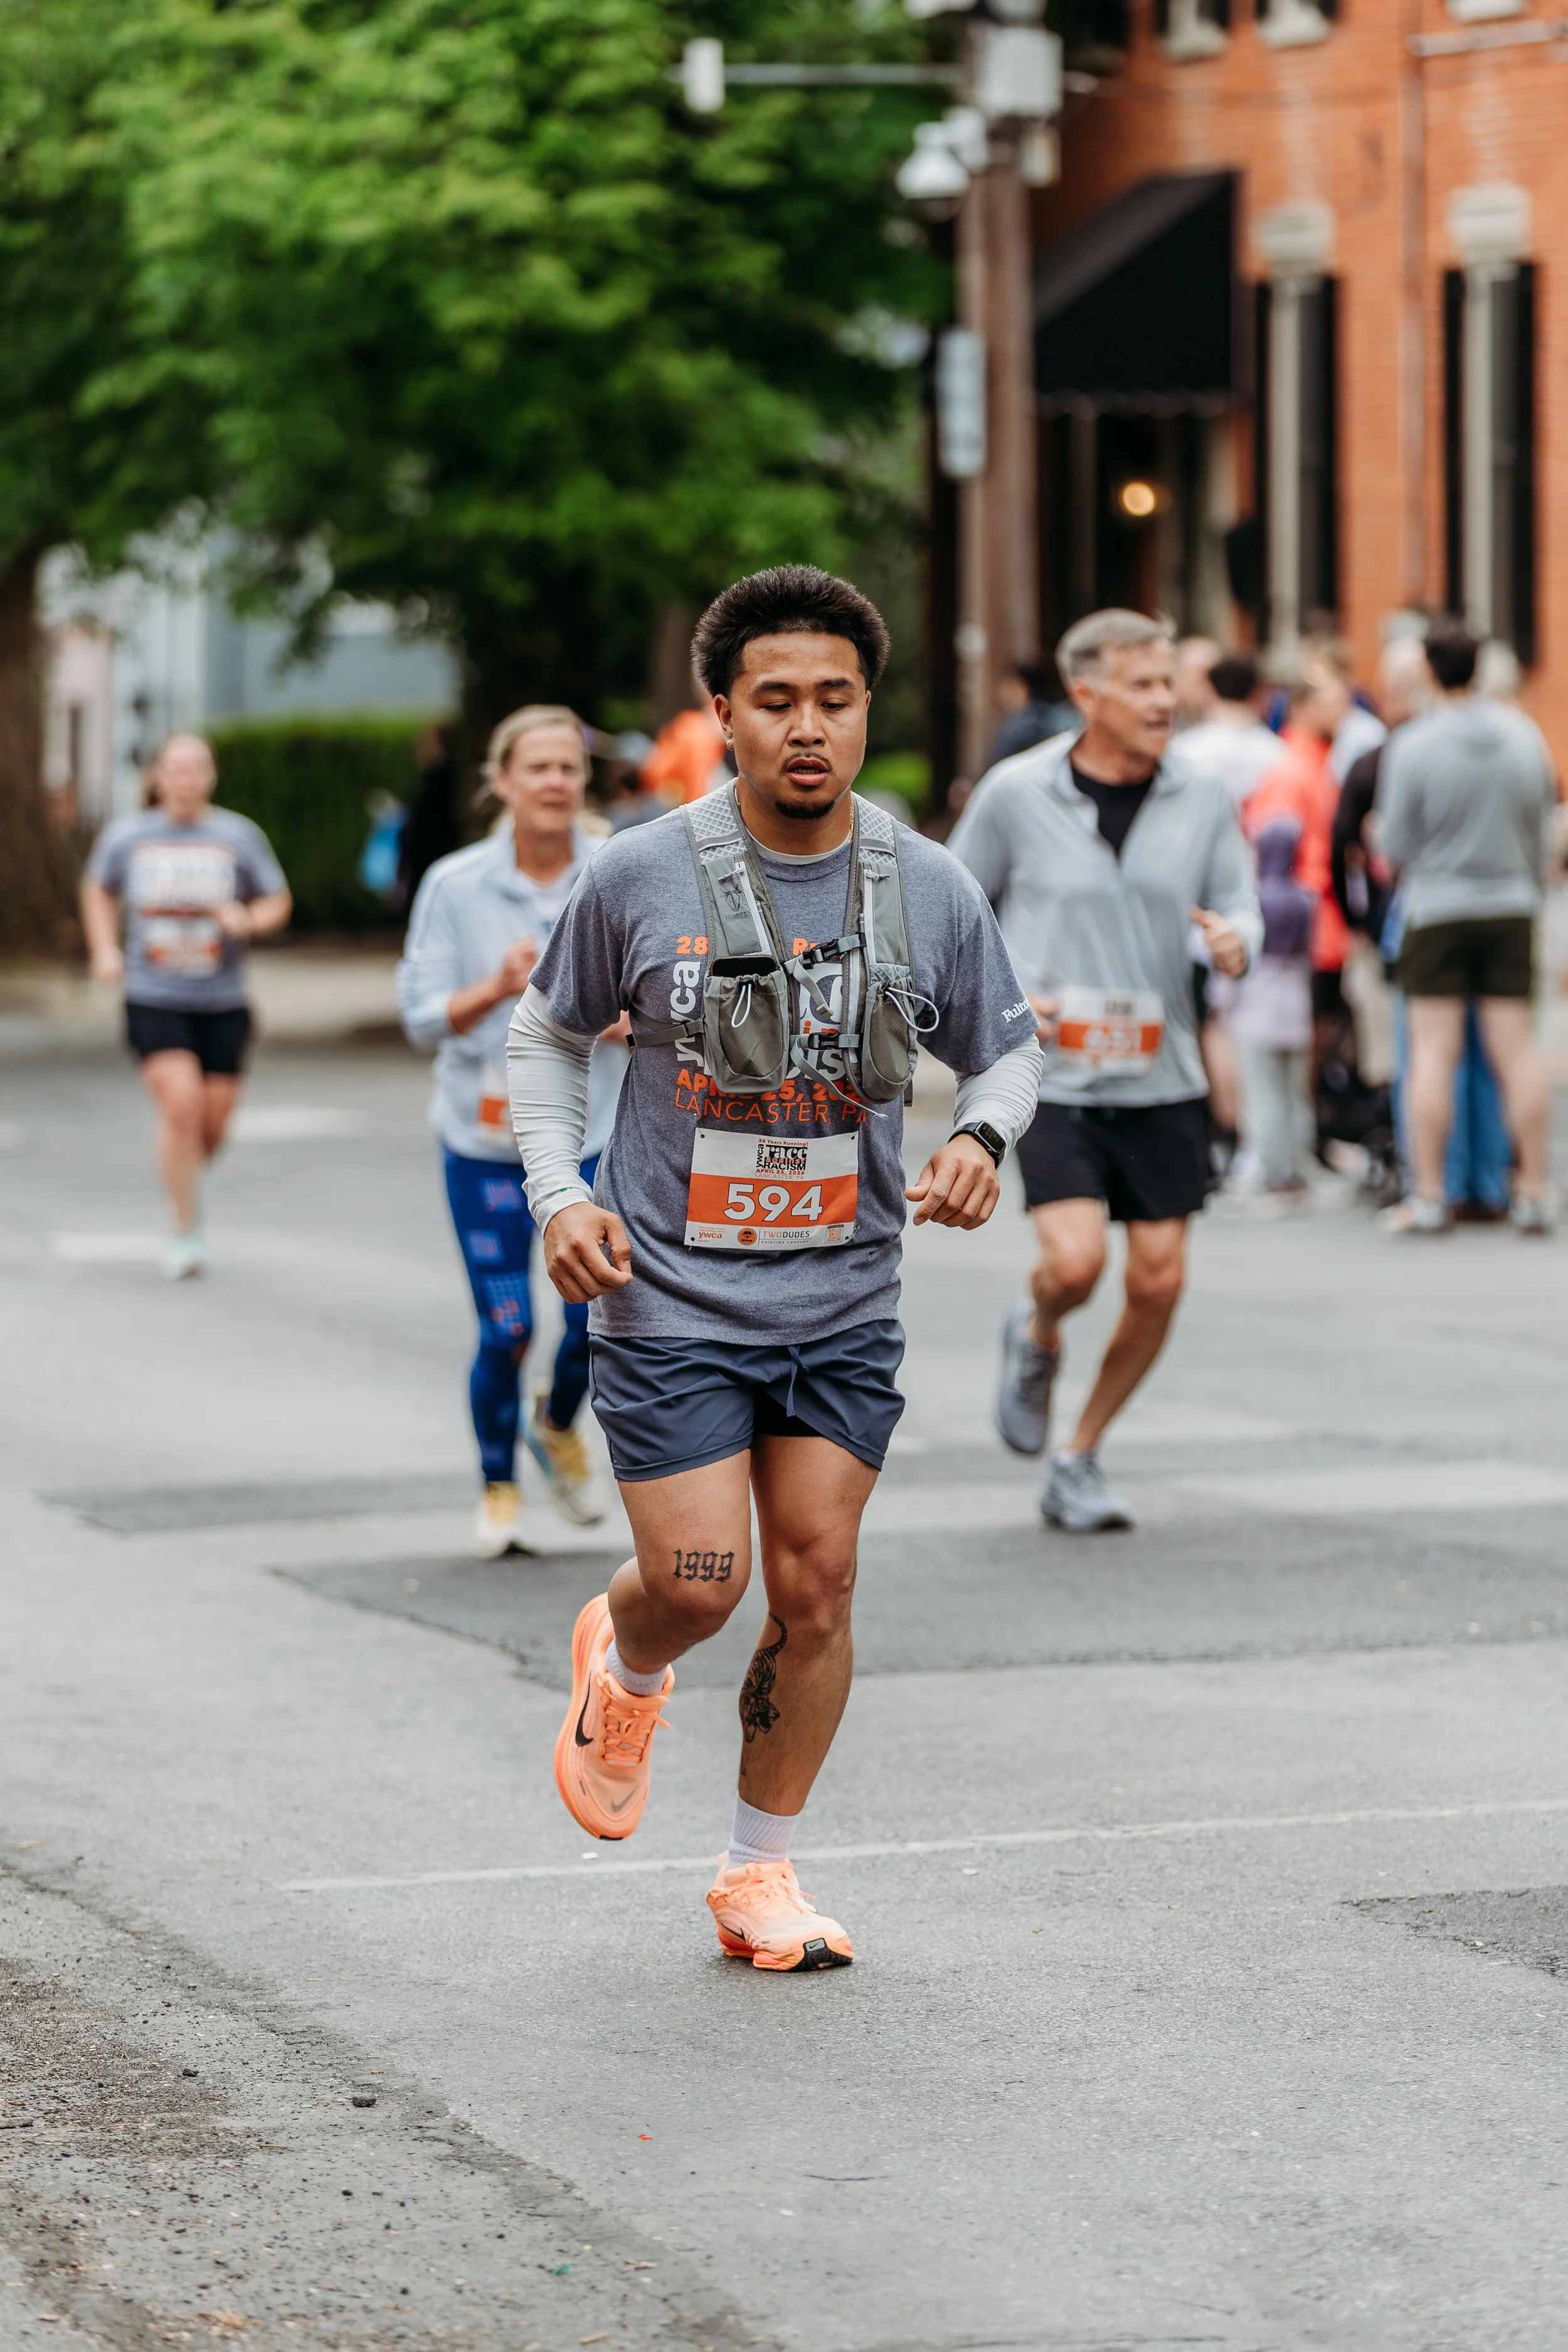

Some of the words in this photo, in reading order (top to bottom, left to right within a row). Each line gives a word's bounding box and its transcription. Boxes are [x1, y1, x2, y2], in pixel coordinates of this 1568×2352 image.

[675, 936, 709, 955] 28
[812, 1081, 868, 1103] 202
[675, 1088, 831, 1125] LANCASTER,
[841, 1103, 867, 1124] PA
[756, 1143, 764, 1168] ywca
[765, 1147, 807, 1160] race
[765, 1157, 805, 1165] against
[763, 1162, 806, 1171] RACISM
[723, 1182, 823, 1222] 594
[672, 1549, 735, 1582] 1999
